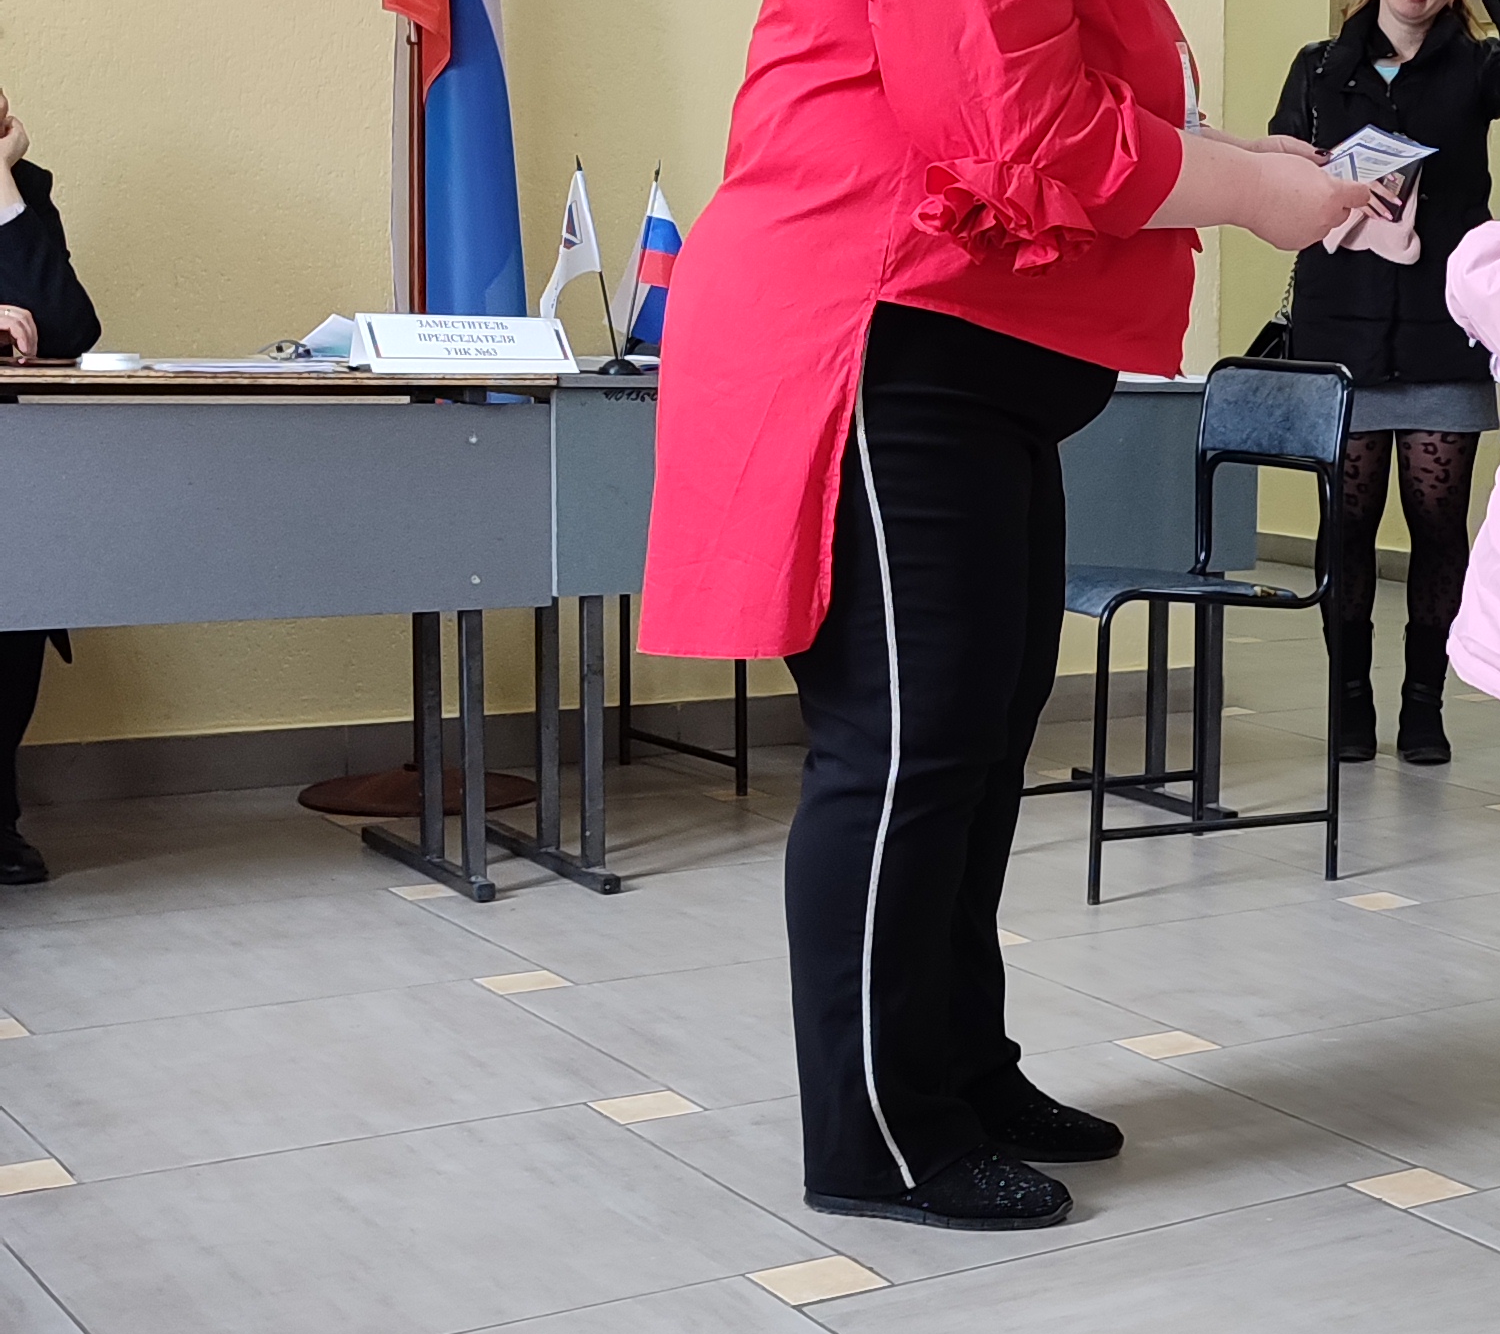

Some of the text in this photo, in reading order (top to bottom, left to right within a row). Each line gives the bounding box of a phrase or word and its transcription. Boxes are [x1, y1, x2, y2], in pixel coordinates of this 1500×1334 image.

[416, 319, 509, 331] ЗАМЕСТИТЕЛЬ
[417, 333, 516, 344] ПРЕДСЕДАТЕЛЯ
[443, 347, 472, 356] УИК
